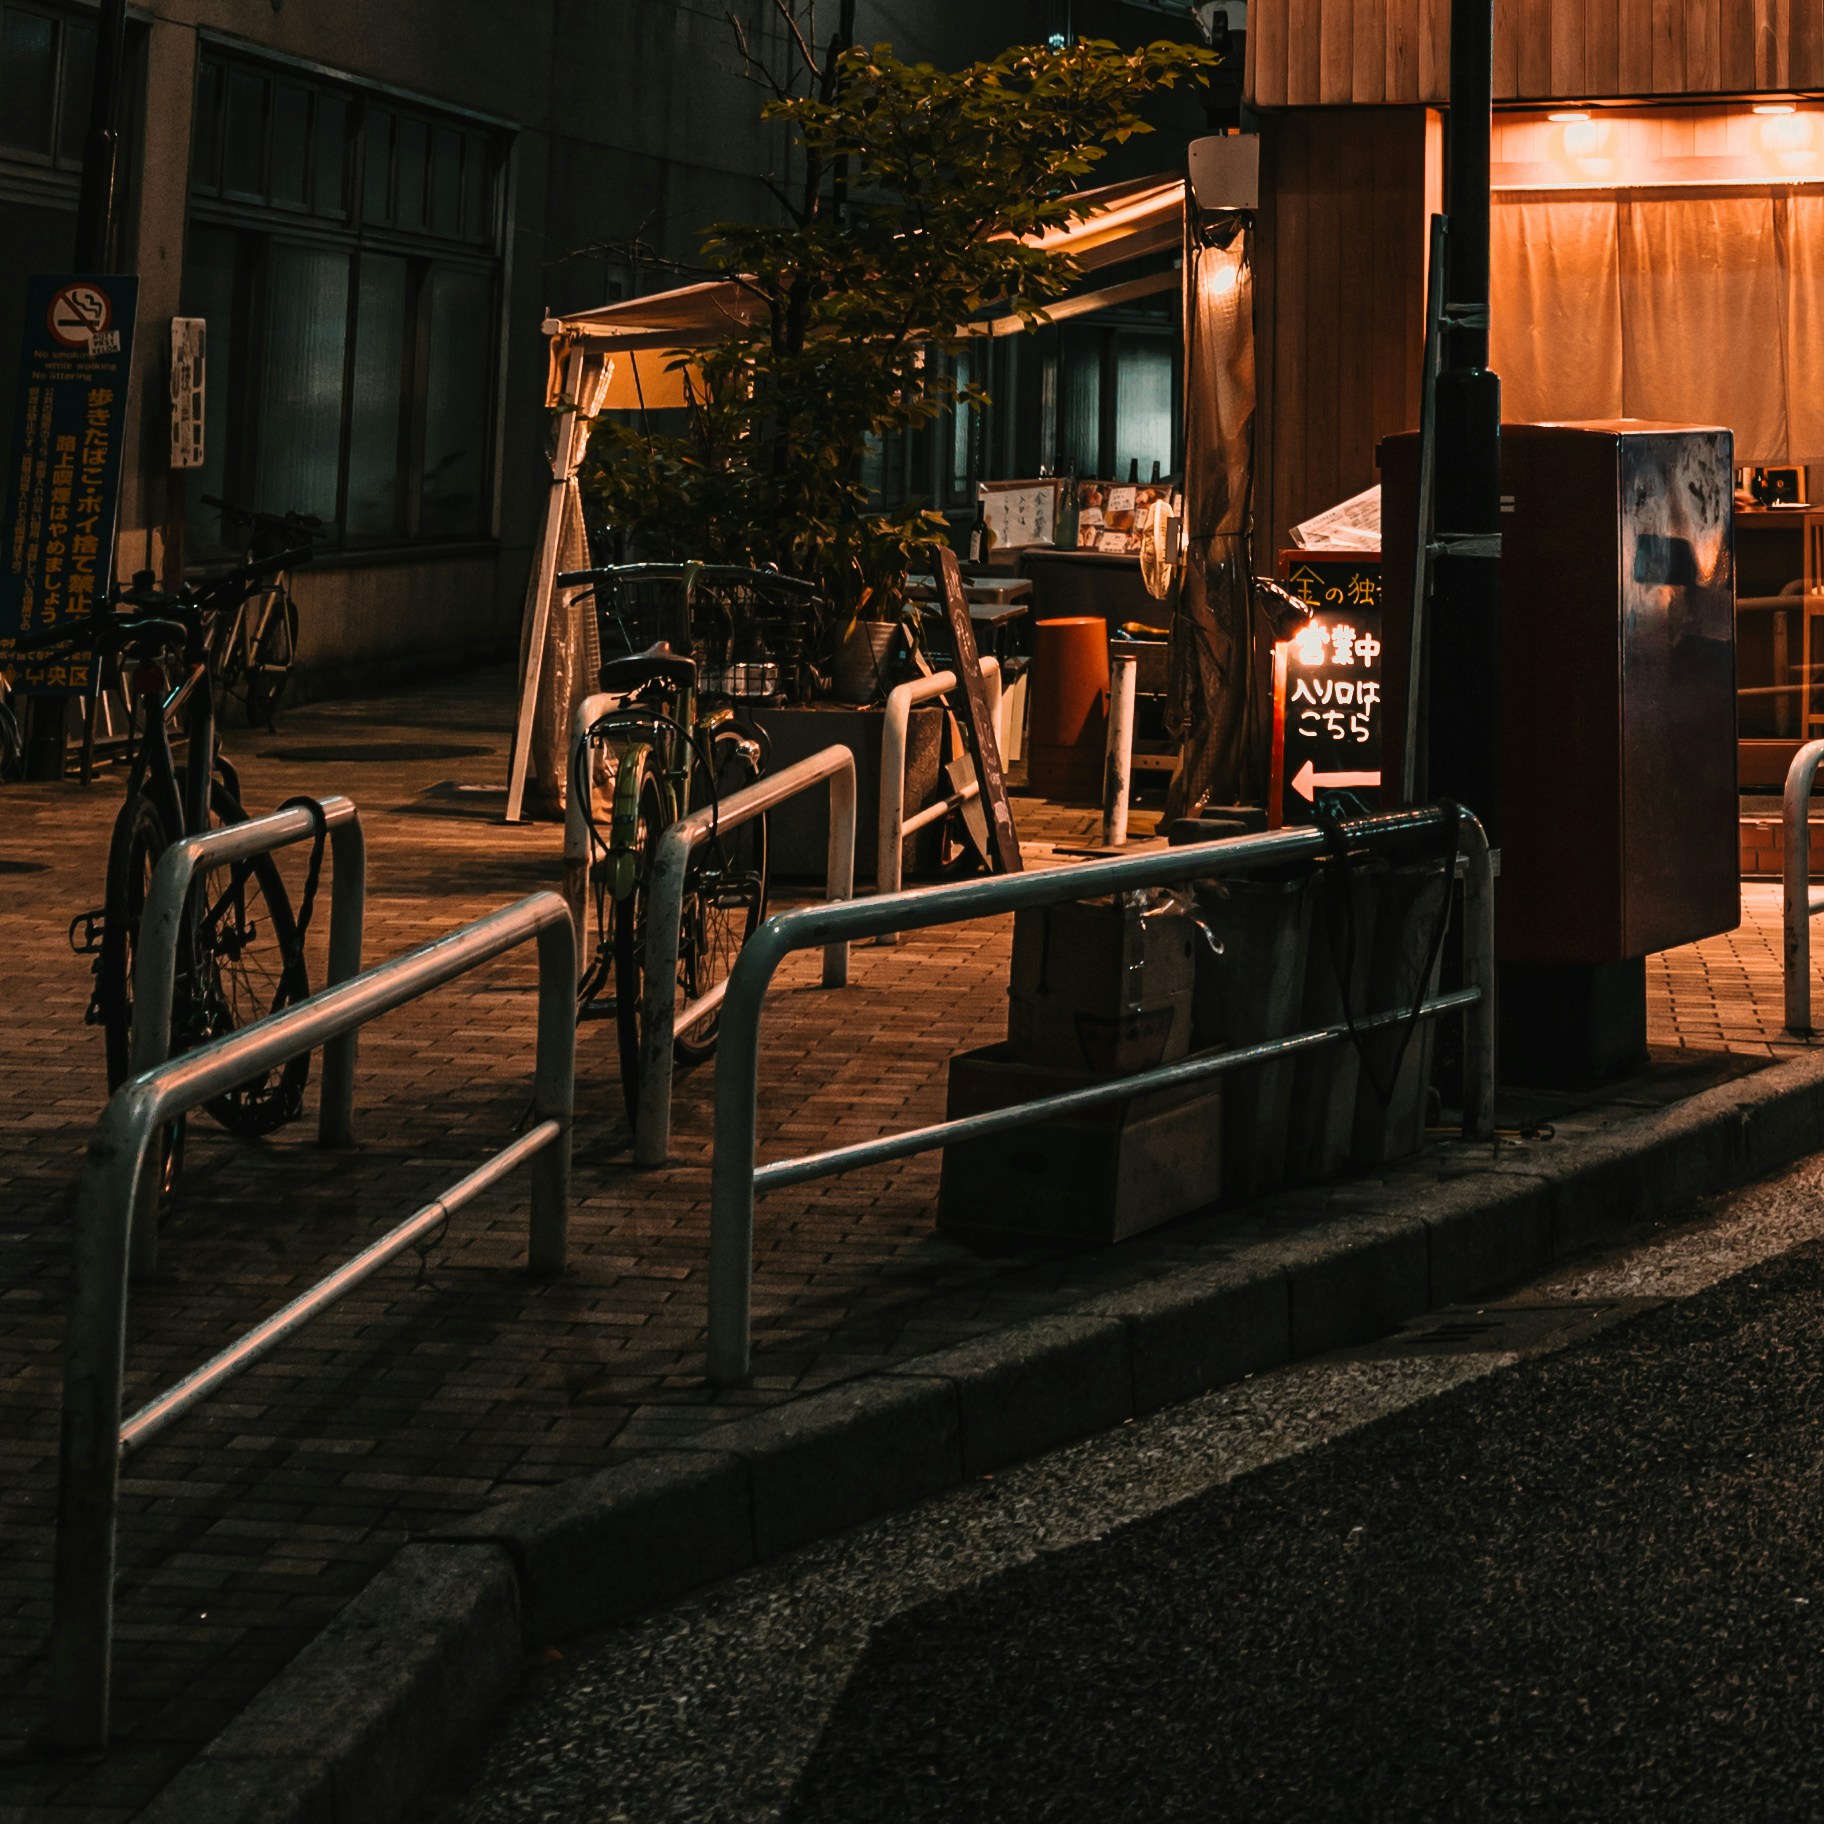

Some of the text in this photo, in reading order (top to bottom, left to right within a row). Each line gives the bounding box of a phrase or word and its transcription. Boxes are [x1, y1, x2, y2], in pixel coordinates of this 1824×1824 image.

[1289, 565, 1382, 606] 金の独
[1294, 620, 1381, 668] 営業中
[1299, 709, 1370, 743] こちら
